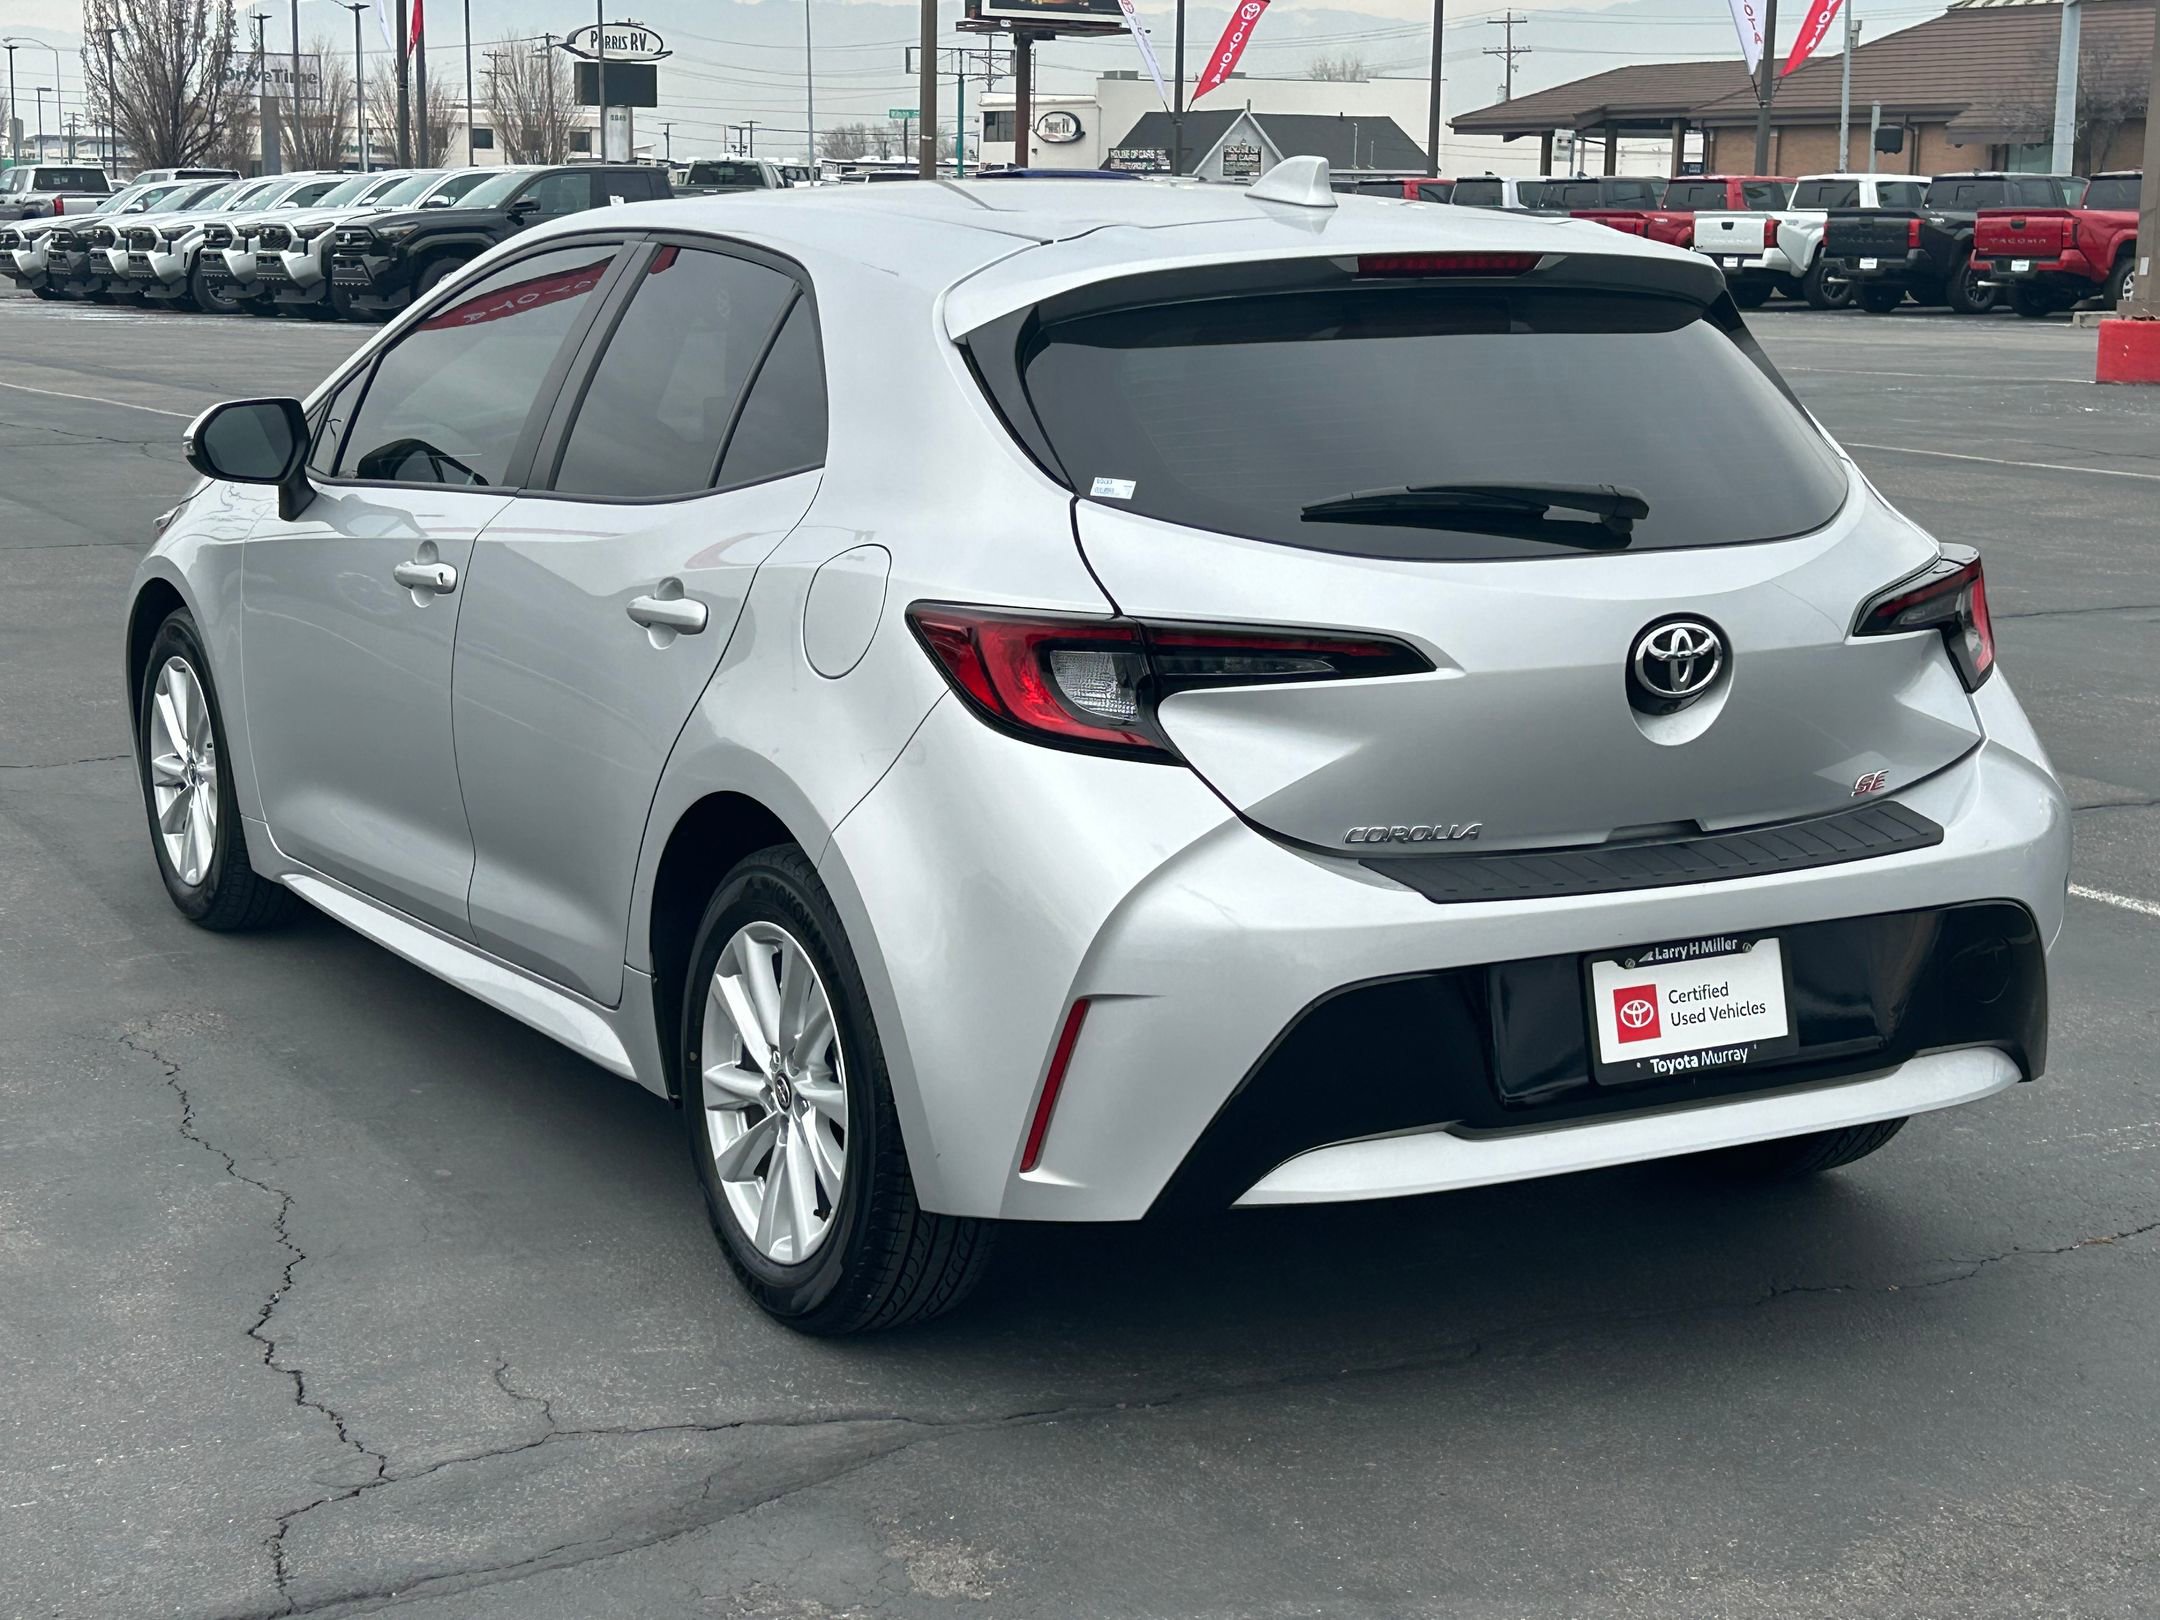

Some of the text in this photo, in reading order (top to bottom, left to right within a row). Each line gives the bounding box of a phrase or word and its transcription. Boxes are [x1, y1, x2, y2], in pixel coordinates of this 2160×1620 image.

[590, 30, 647, 51] PRRIS RV
[1211, 21, 1248, 84] TOYOTA
[1343, 823, 1483, 844] COROLLA
[1655, 937, 1738, 960] Larry H Miller
[1668, 981, 1729, 1004] Certified
[1670, 1000, 1766, 1027] Used Vehicles
[1650, 1047, 1748, 1075] Toyota Murray
